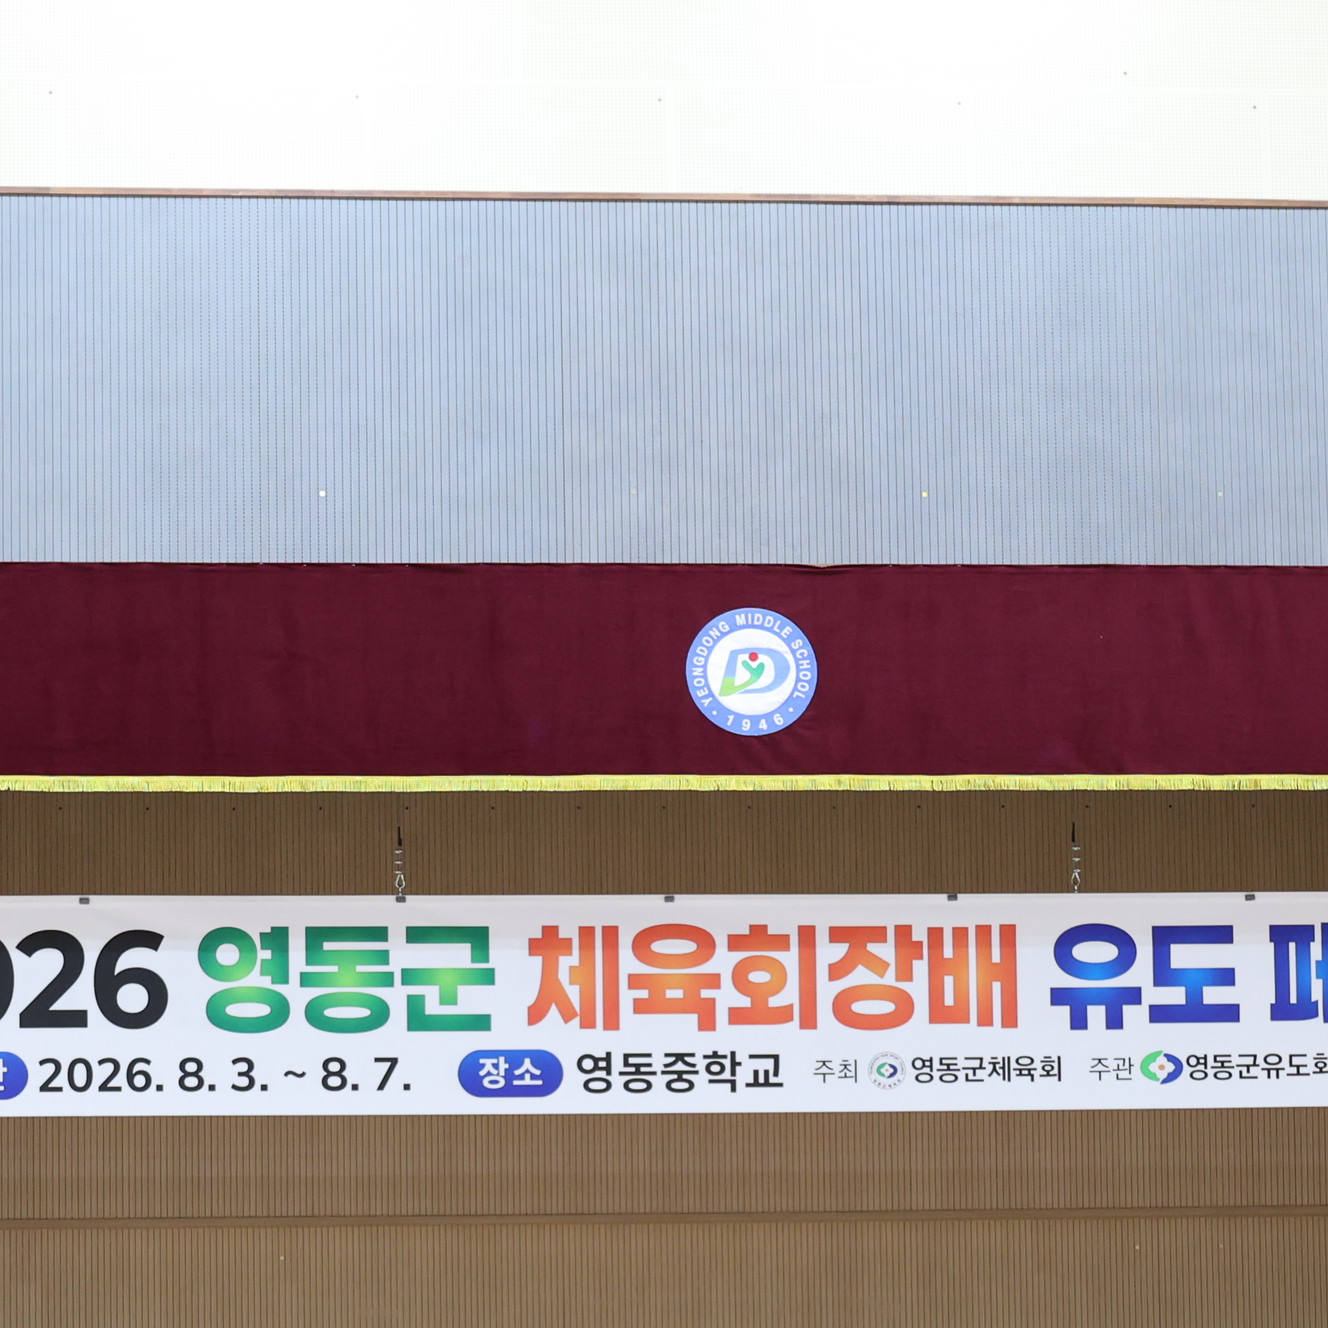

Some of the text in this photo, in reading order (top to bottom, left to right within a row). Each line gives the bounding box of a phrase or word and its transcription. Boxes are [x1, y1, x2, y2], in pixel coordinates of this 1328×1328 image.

[692, 613, 812, 707] YEONGDONG MIDDLE SCHOOL
[726, 713, 784, 731] 1946
[197, 925, 496, 1034] 영동군
[527, 923, 1019, 1032] 체육회장배
[1050, 922, 1240, 1030] 유도
[39, 1058, 163, 1092] 2026.
[479, 1051, 783, 1093] 장소 영동중학교
[814, 1060, 857, 1083] 주최
[912, 1056, 1061, 1083] 영동군체육회
[1090, 1058, 1133, 1081] 주관
